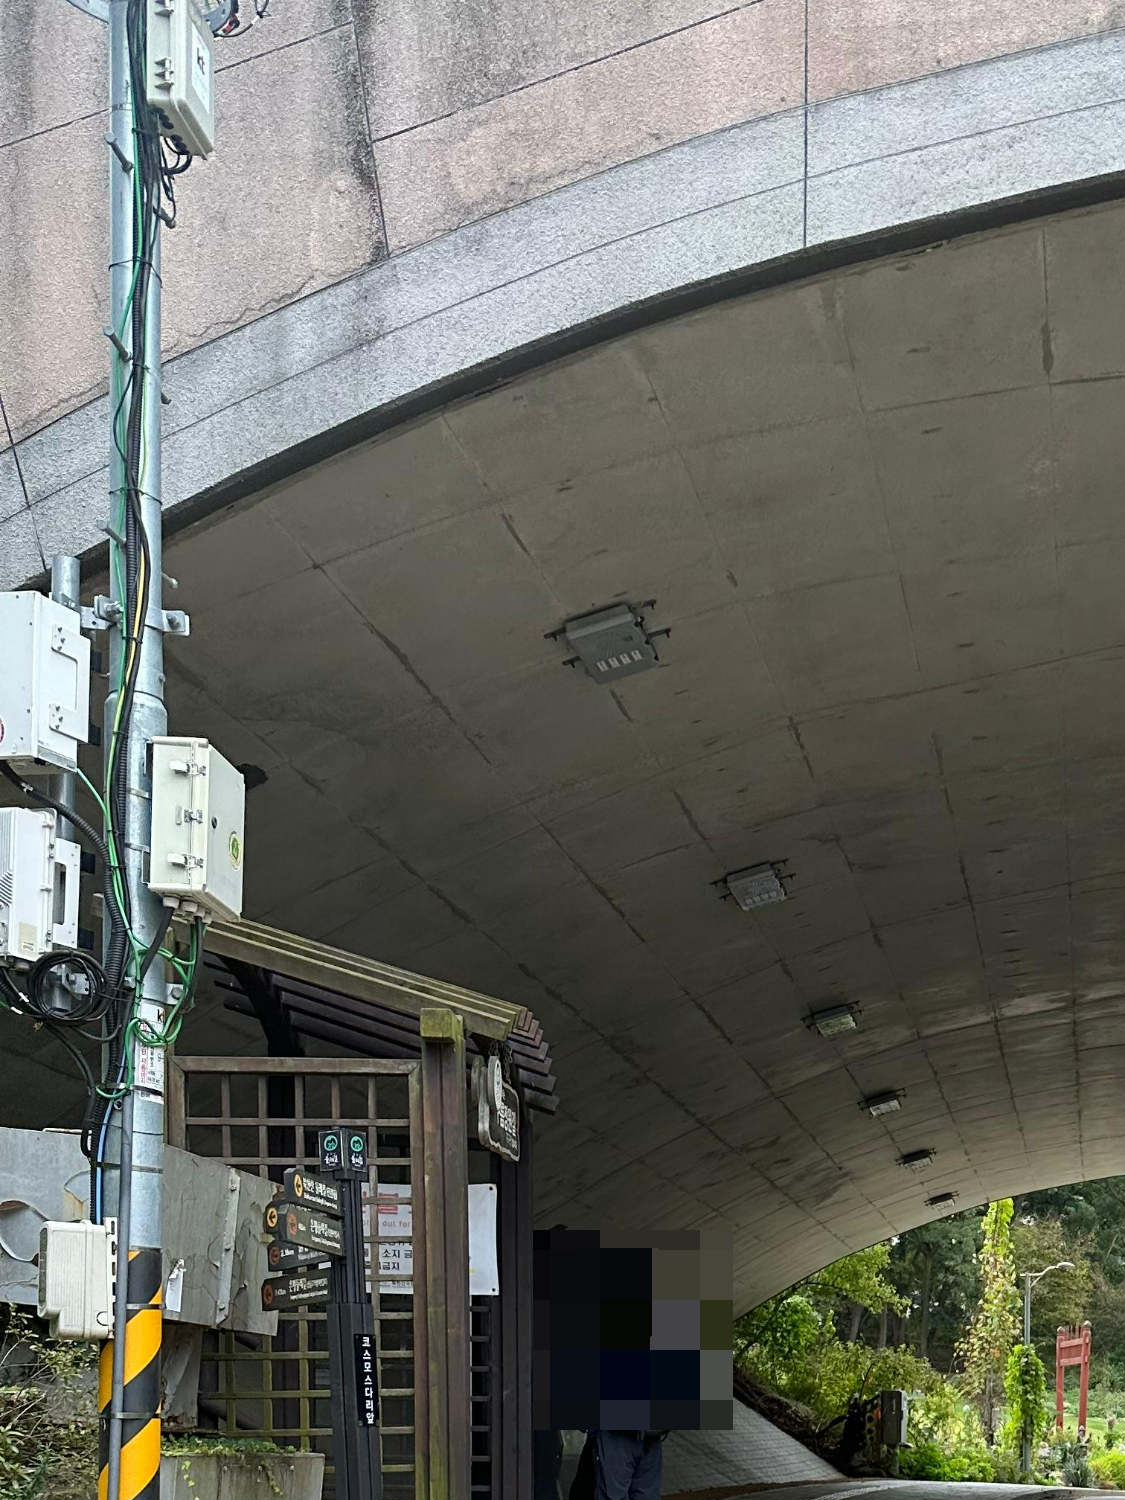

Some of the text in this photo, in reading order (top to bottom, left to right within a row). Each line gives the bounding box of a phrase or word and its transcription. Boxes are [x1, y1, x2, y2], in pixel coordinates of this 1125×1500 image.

[382, 1249, 400, 1258] 소지
[379, 1261, 400, 1271] 금지
[362, 1336, 375, 1424] 코스모스다리앞
